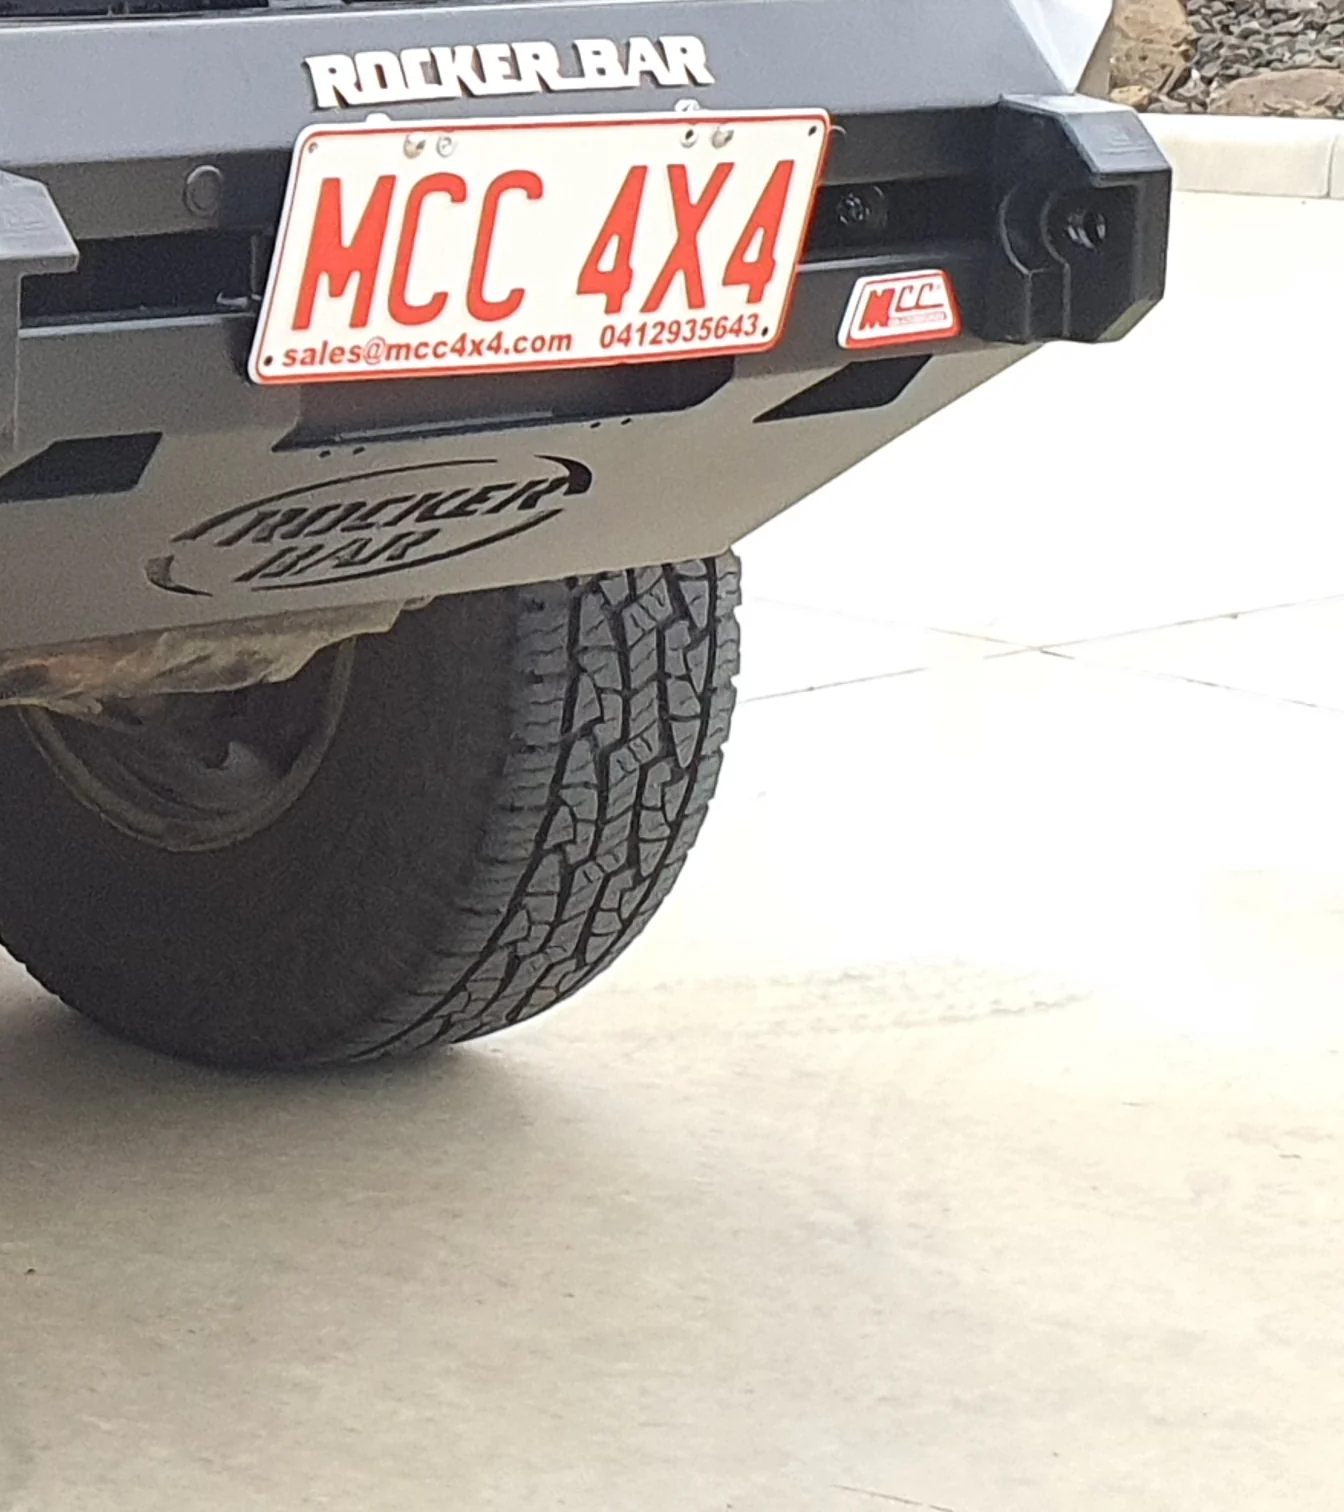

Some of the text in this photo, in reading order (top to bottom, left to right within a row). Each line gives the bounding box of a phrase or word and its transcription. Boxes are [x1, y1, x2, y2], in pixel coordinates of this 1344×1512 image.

[304, 35, 715, 109] ROCKER BAR
[291, 159, 795, 330] MCC 4X4
[859, 282, 945, 331] MCC
[282, 313, 759, 368] sales@mcc4x4.com 0412935643
[214, 476, 572, 547] ROCKER
[234, 528, 443, 583] BAR
